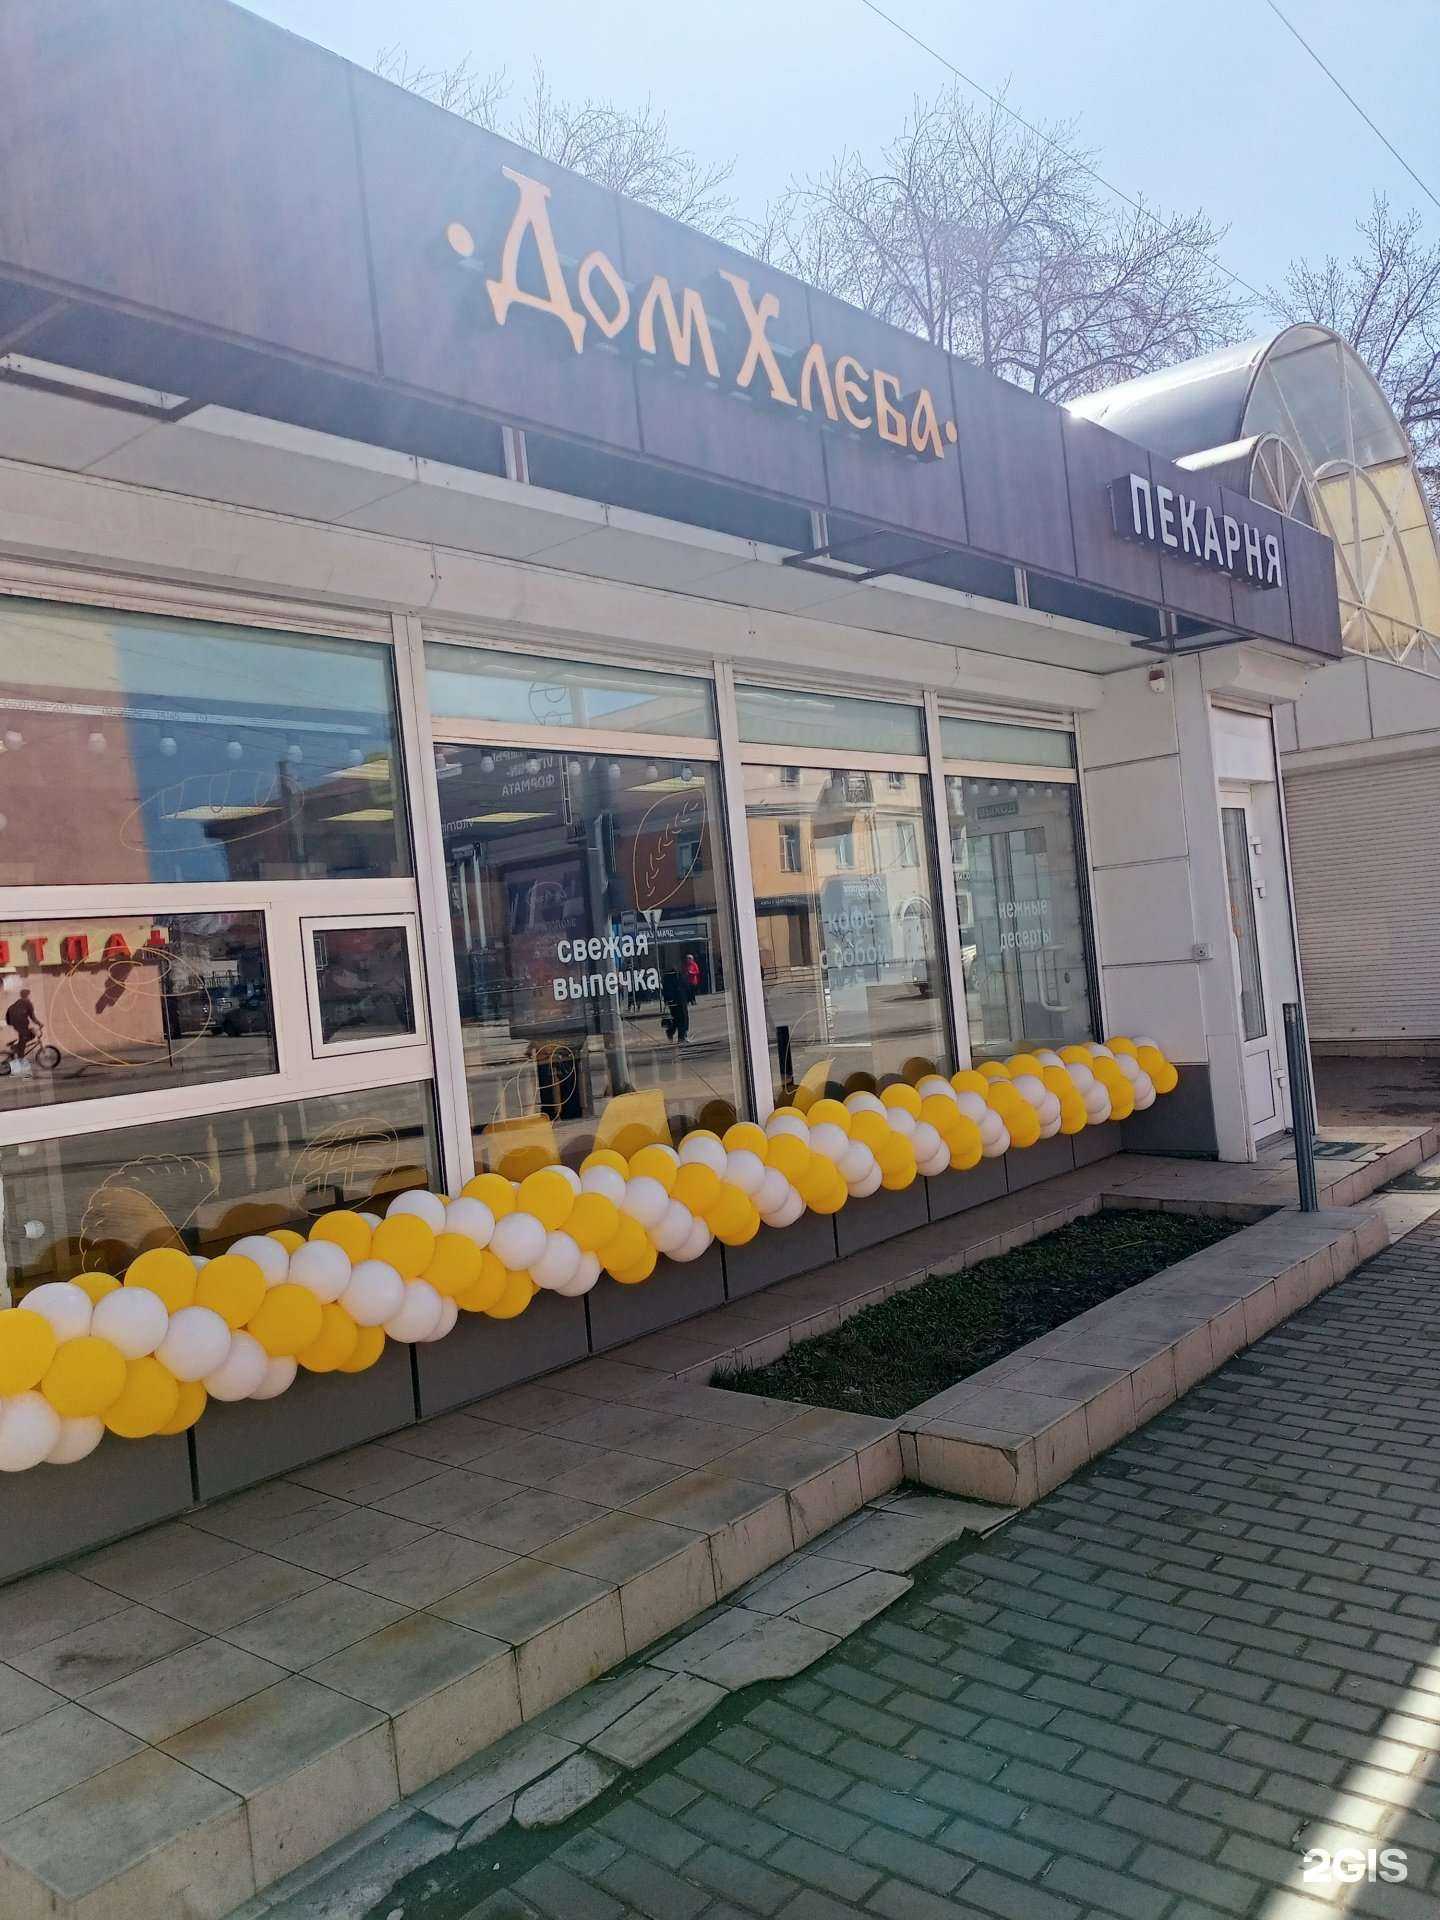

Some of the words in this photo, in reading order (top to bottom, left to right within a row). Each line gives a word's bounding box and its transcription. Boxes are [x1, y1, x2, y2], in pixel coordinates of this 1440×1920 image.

[1129, 472, 1282, 588] ПЕКАРНЯ
[998, 899, 1048, 919] нежные
[557, 934, 649, 963] свежая
[1000, 928, 1052, 952] десерты
[552, 967, 660, 1001] выпечка
